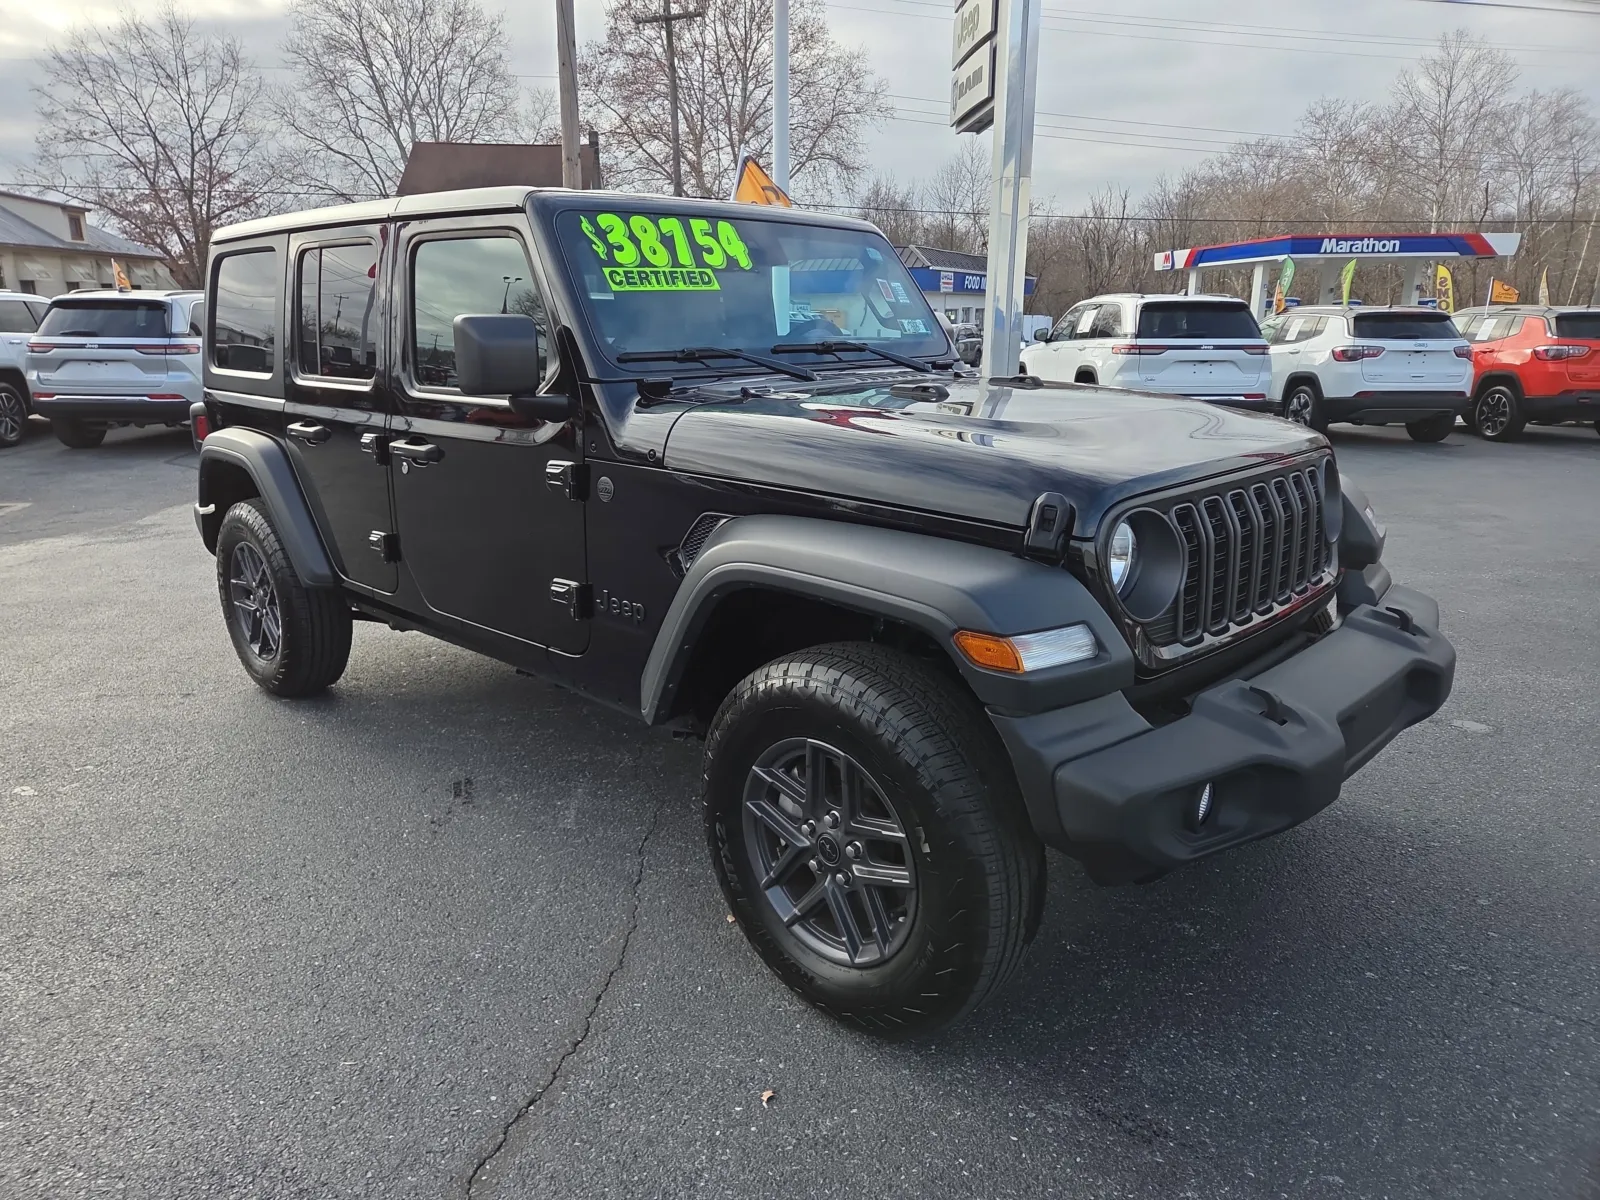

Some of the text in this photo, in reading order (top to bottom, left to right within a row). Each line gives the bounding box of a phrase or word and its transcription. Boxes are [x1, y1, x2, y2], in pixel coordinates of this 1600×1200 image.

[957, 3, 980, 49] Jeep
[958, 65, 983, 101] RAM
[579, 212, 751, 271] $38754
[1320, 238, 1400, 254] Marathon
[608, 269, 716, 289] CERTIFIED
[964, 275, 980, 290] FOOD
[596, 589, 645, 625] Jeep
